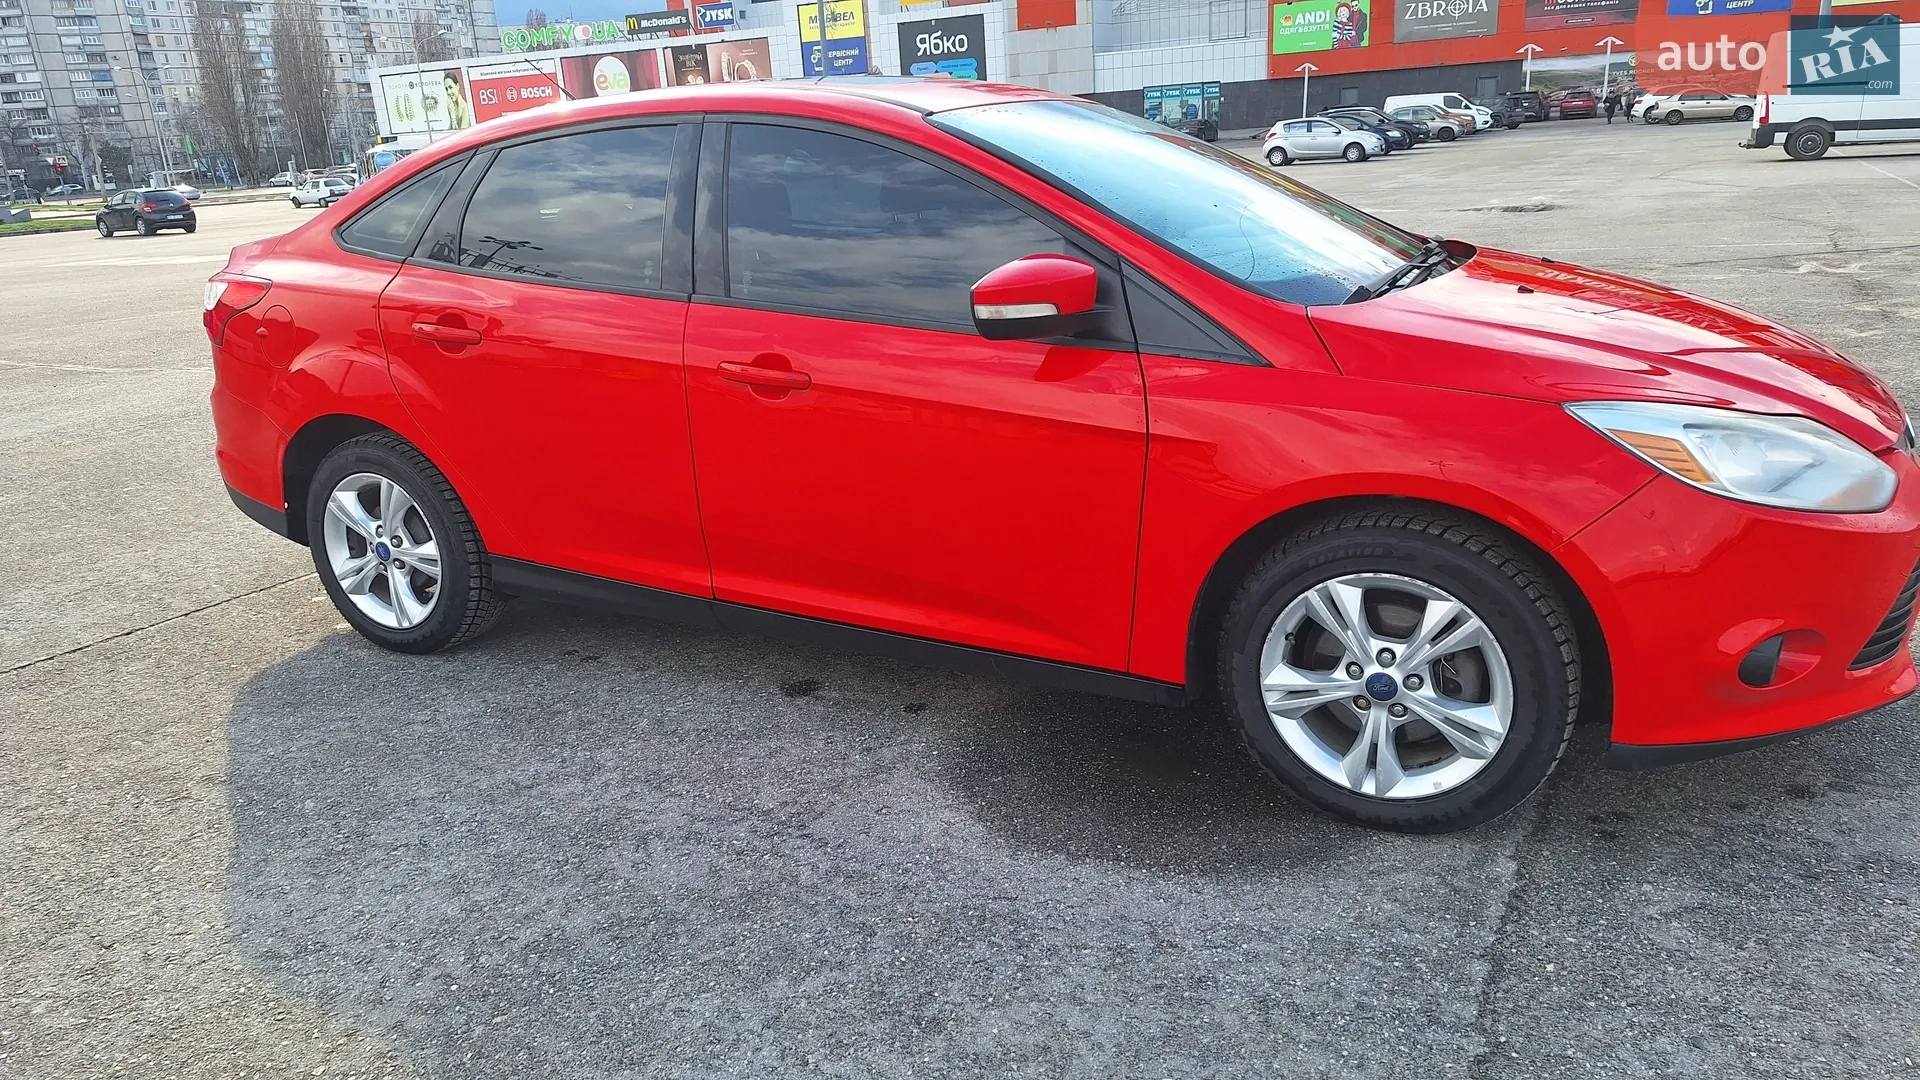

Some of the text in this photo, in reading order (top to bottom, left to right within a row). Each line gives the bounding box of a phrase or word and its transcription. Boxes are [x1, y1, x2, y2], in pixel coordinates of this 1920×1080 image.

[1726, 0, 1754, 9] ЦЕНТР
[704, 8, 733, 21] JYSK
[1295, 10, 1330, 25] ANDI
[640, 16, 686, 28] McDonald's
[503, 25, 574, 49] COMFY
[916, 30, 968, 57] Ябко
[828, 47, 859, 58] ЕРВІСНИЙ
[834, 58, 853, 67] ЦЕНТР
[521, 86, 553, 99] BOSCH
